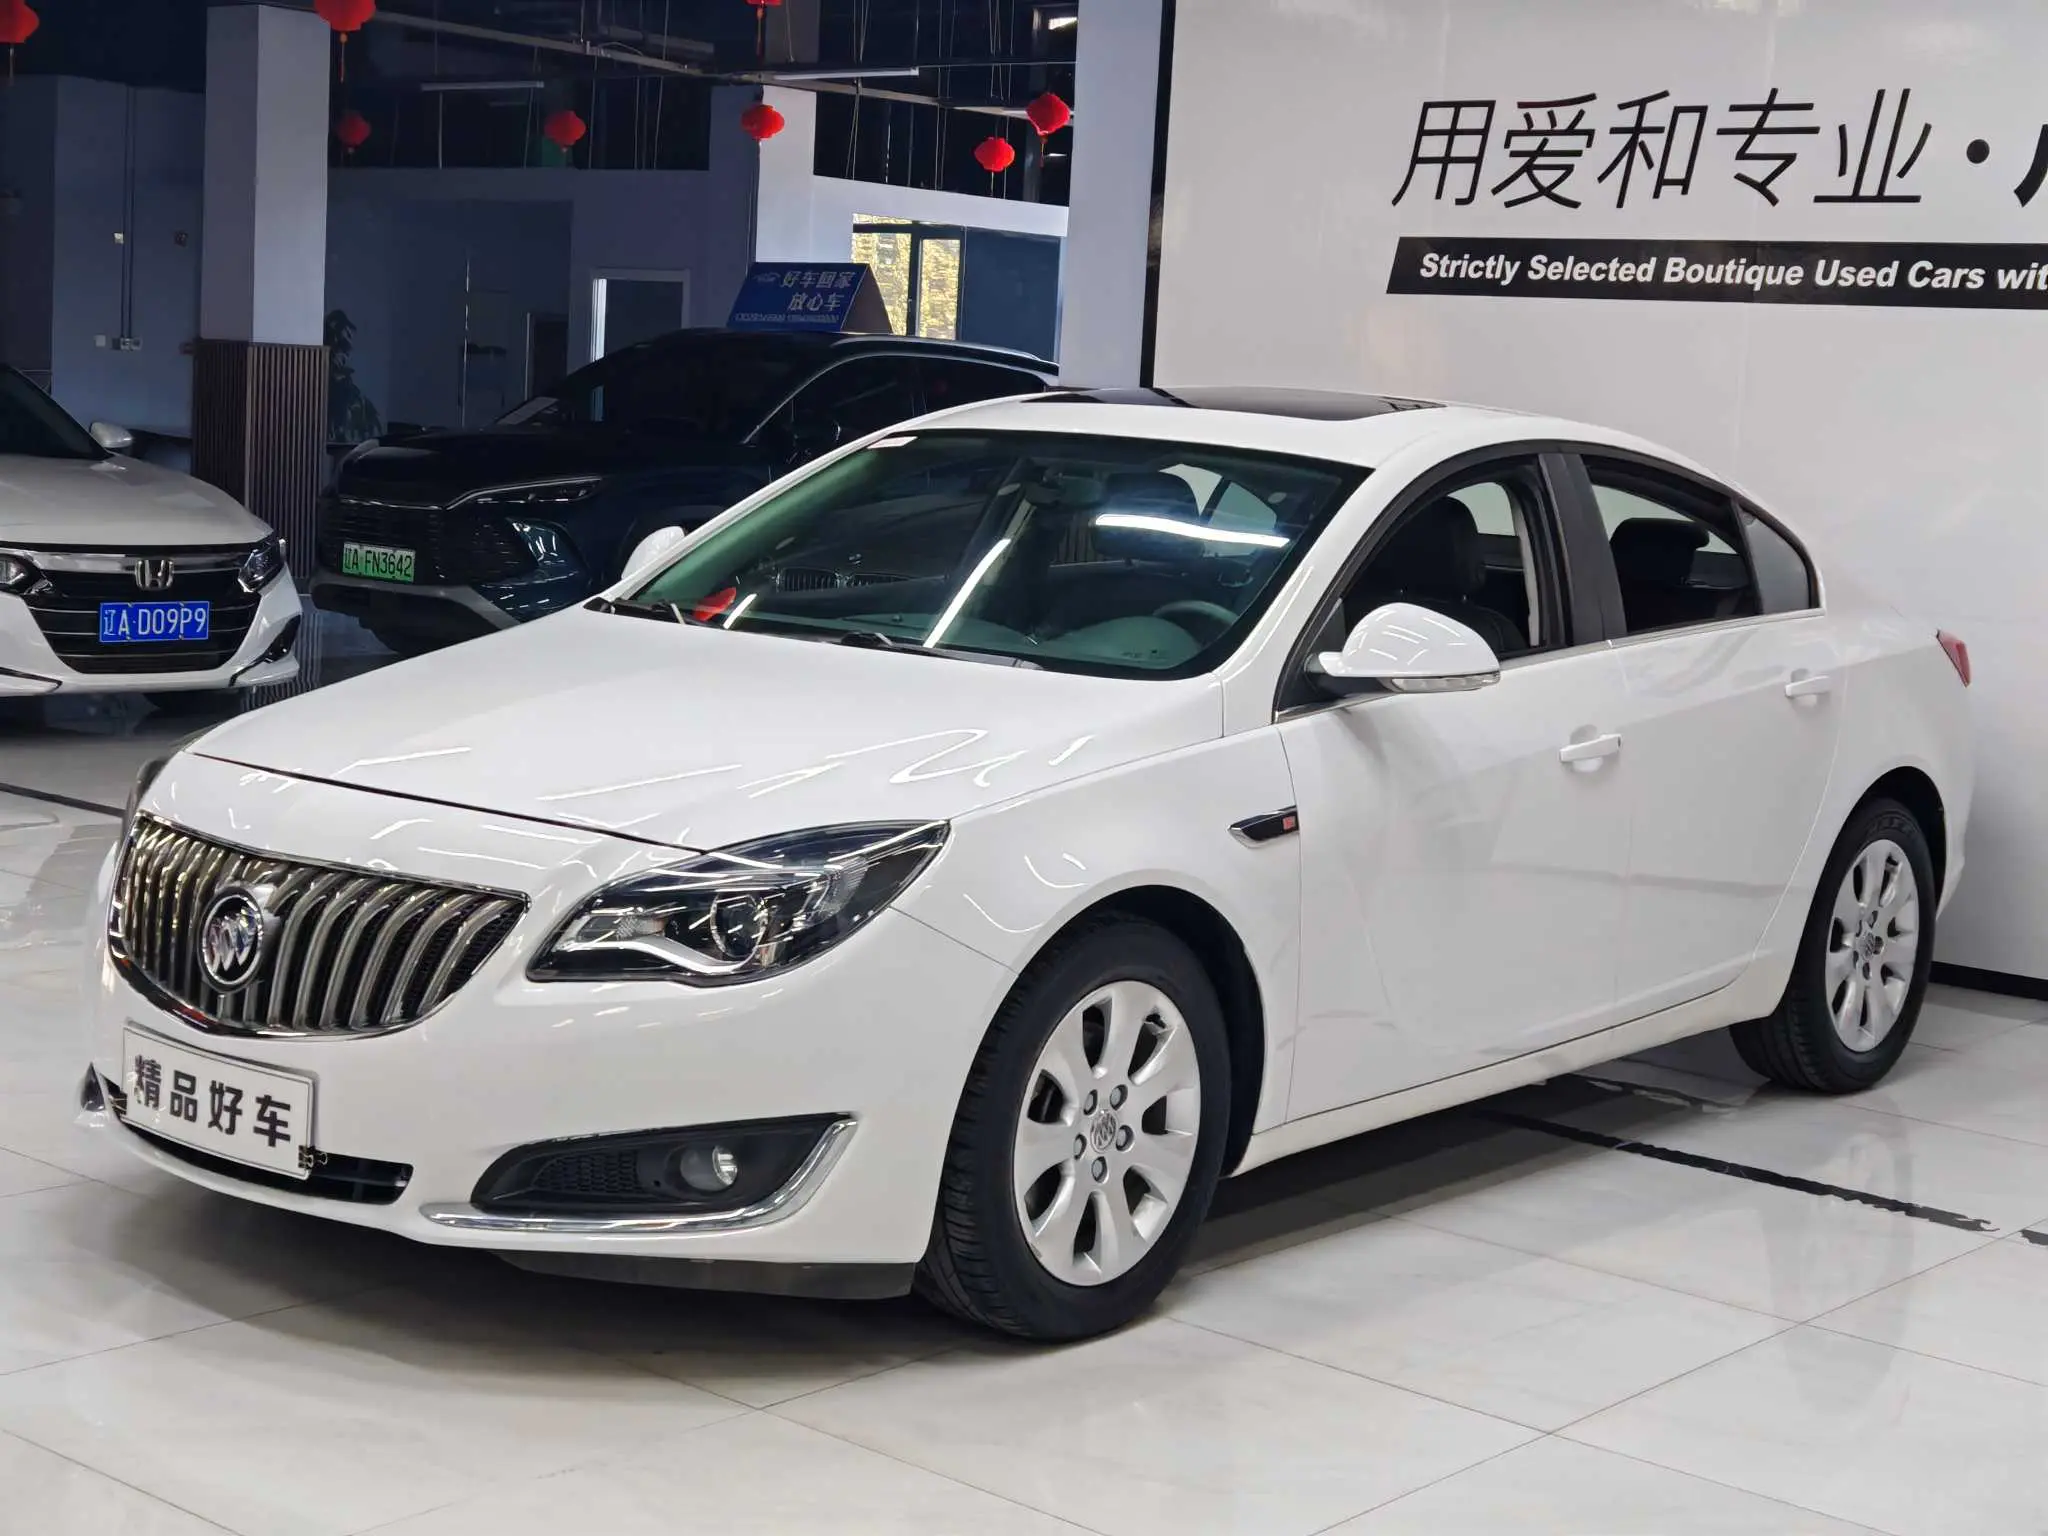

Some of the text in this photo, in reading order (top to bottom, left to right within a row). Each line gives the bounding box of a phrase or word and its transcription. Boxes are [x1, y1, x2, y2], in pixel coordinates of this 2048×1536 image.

[1391, 87, 2048, 209] 用爱和专业·
[1419, 252, 1520, 285] Strictly
[1527, 253, 1656, 284] Selected
[1663, 256, 1805, 291] Boutique
[1814, 259, 1899, 288] Used
[1907, 260, 1986, 289] Cars
[134, 1055, 291, 1147] 精品好车
